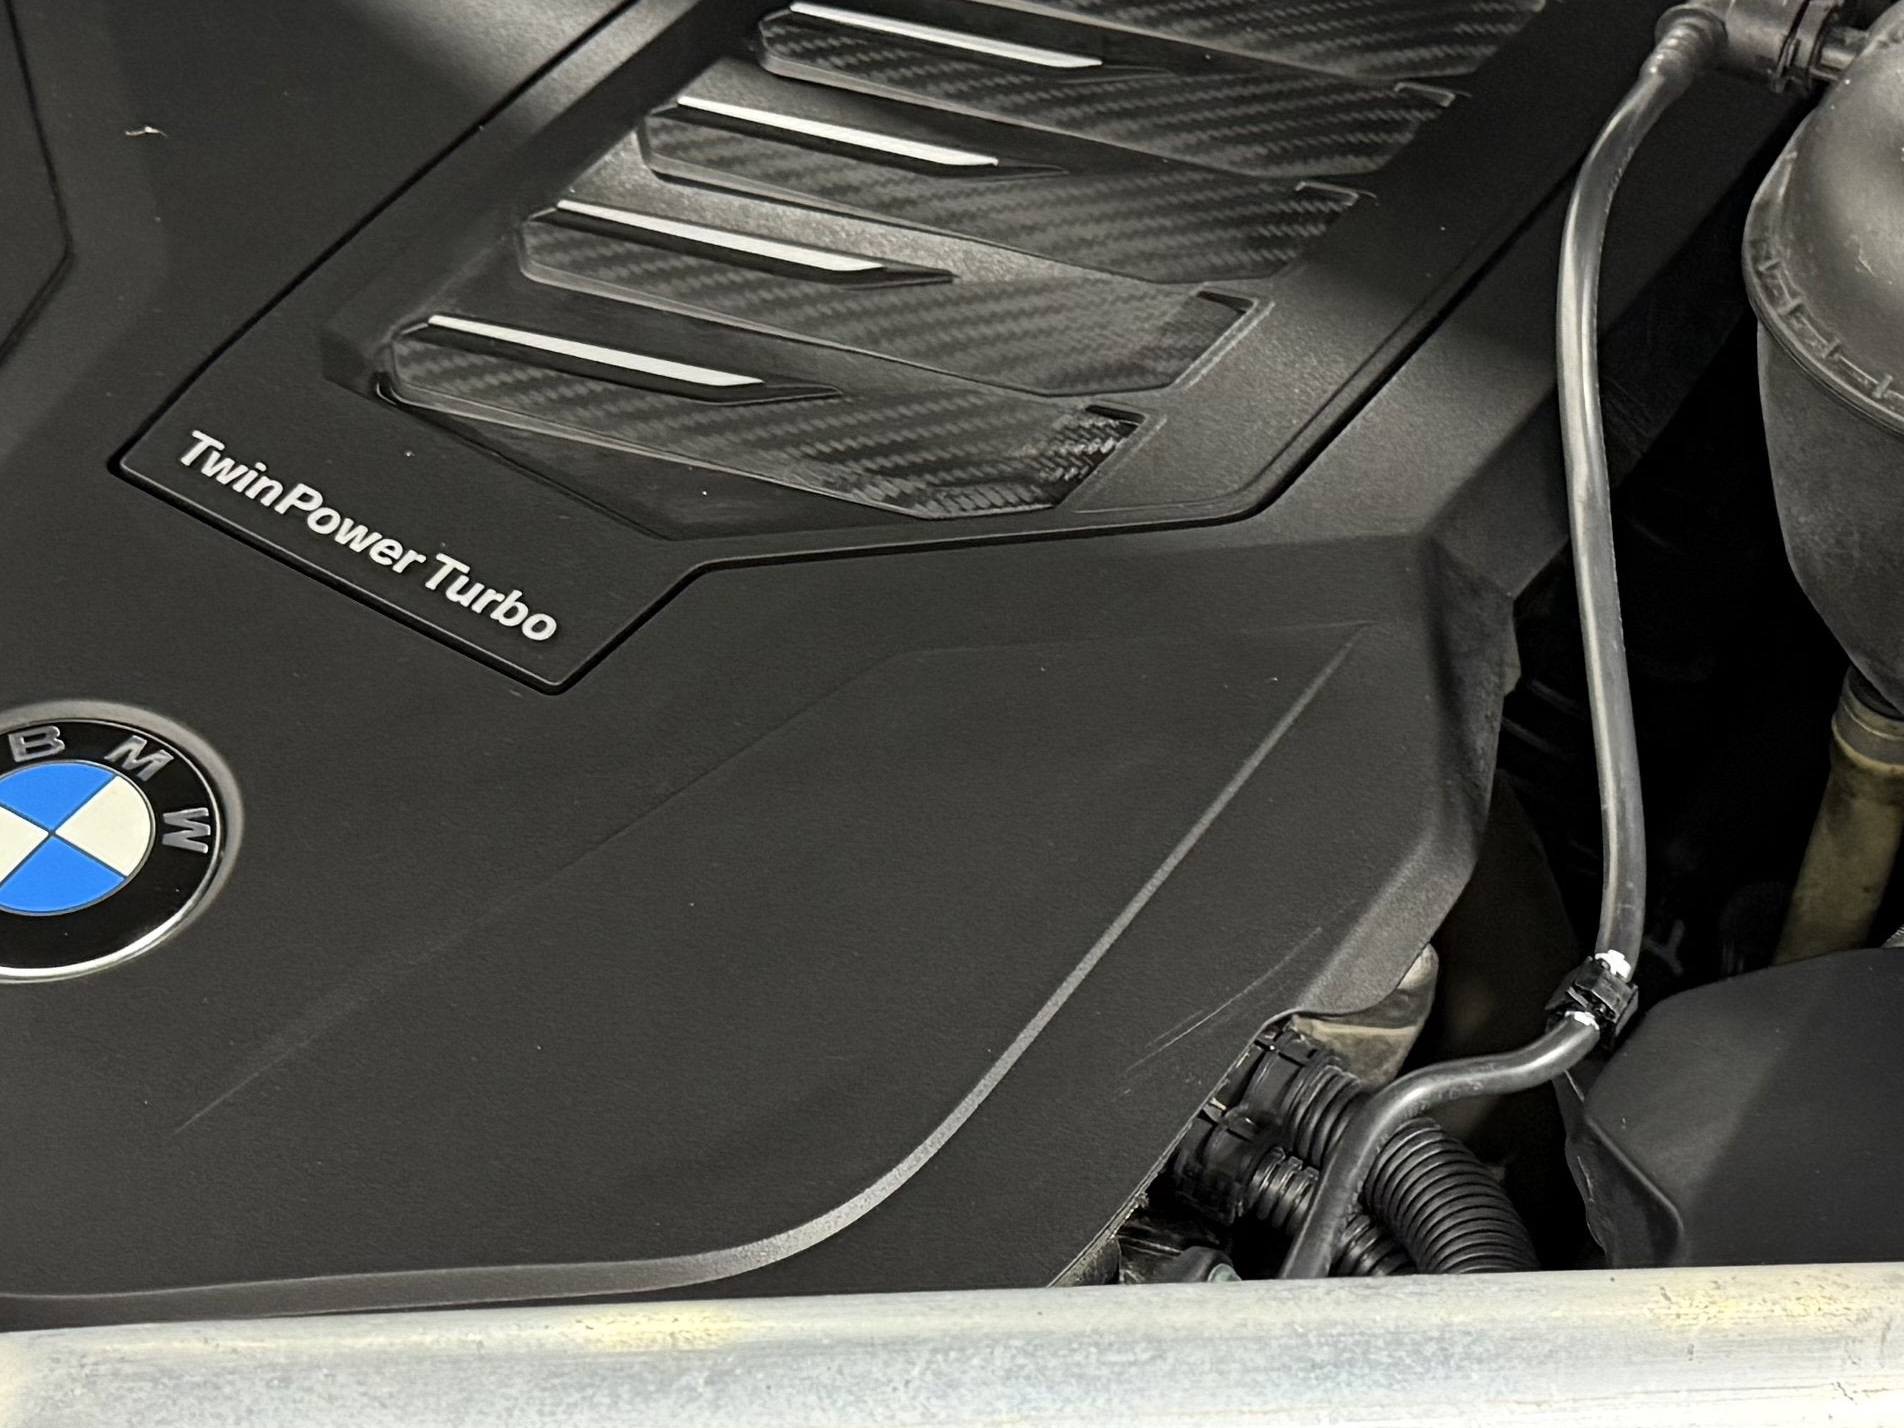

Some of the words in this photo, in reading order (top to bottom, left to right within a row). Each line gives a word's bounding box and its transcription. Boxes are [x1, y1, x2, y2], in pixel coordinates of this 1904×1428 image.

[180, 430, 427, 573] TwinPower
[425, 553, 557, 641] Turbo
[8, 725, 212, 854] BMW
